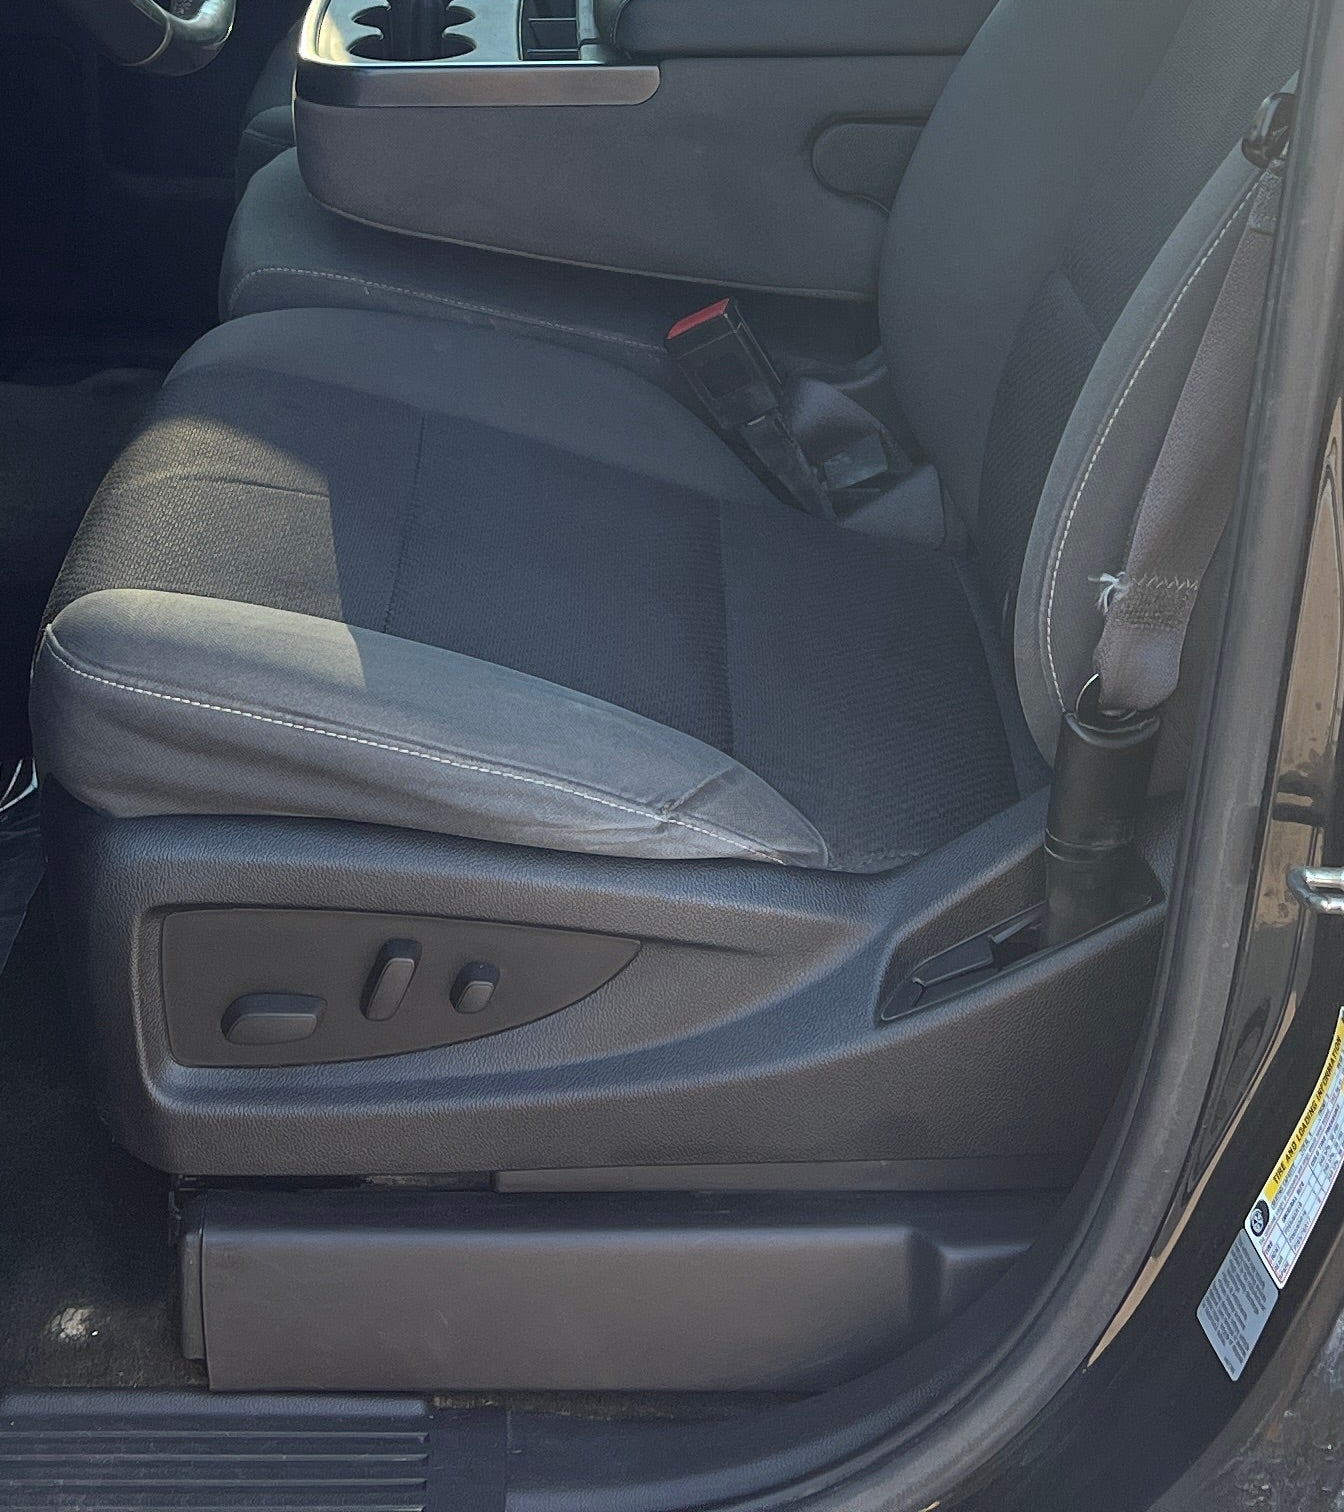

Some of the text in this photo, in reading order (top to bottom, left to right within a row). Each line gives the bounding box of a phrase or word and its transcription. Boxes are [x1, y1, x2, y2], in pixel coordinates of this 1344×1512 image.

[1272, 1161, 1286, 1185] TIRE
[1285, 1141, 1298, 1163] AND
[1296, 1099, 1318, 1143] LOADING
[1315, 1034, 1342, 1101] INFORMATION
